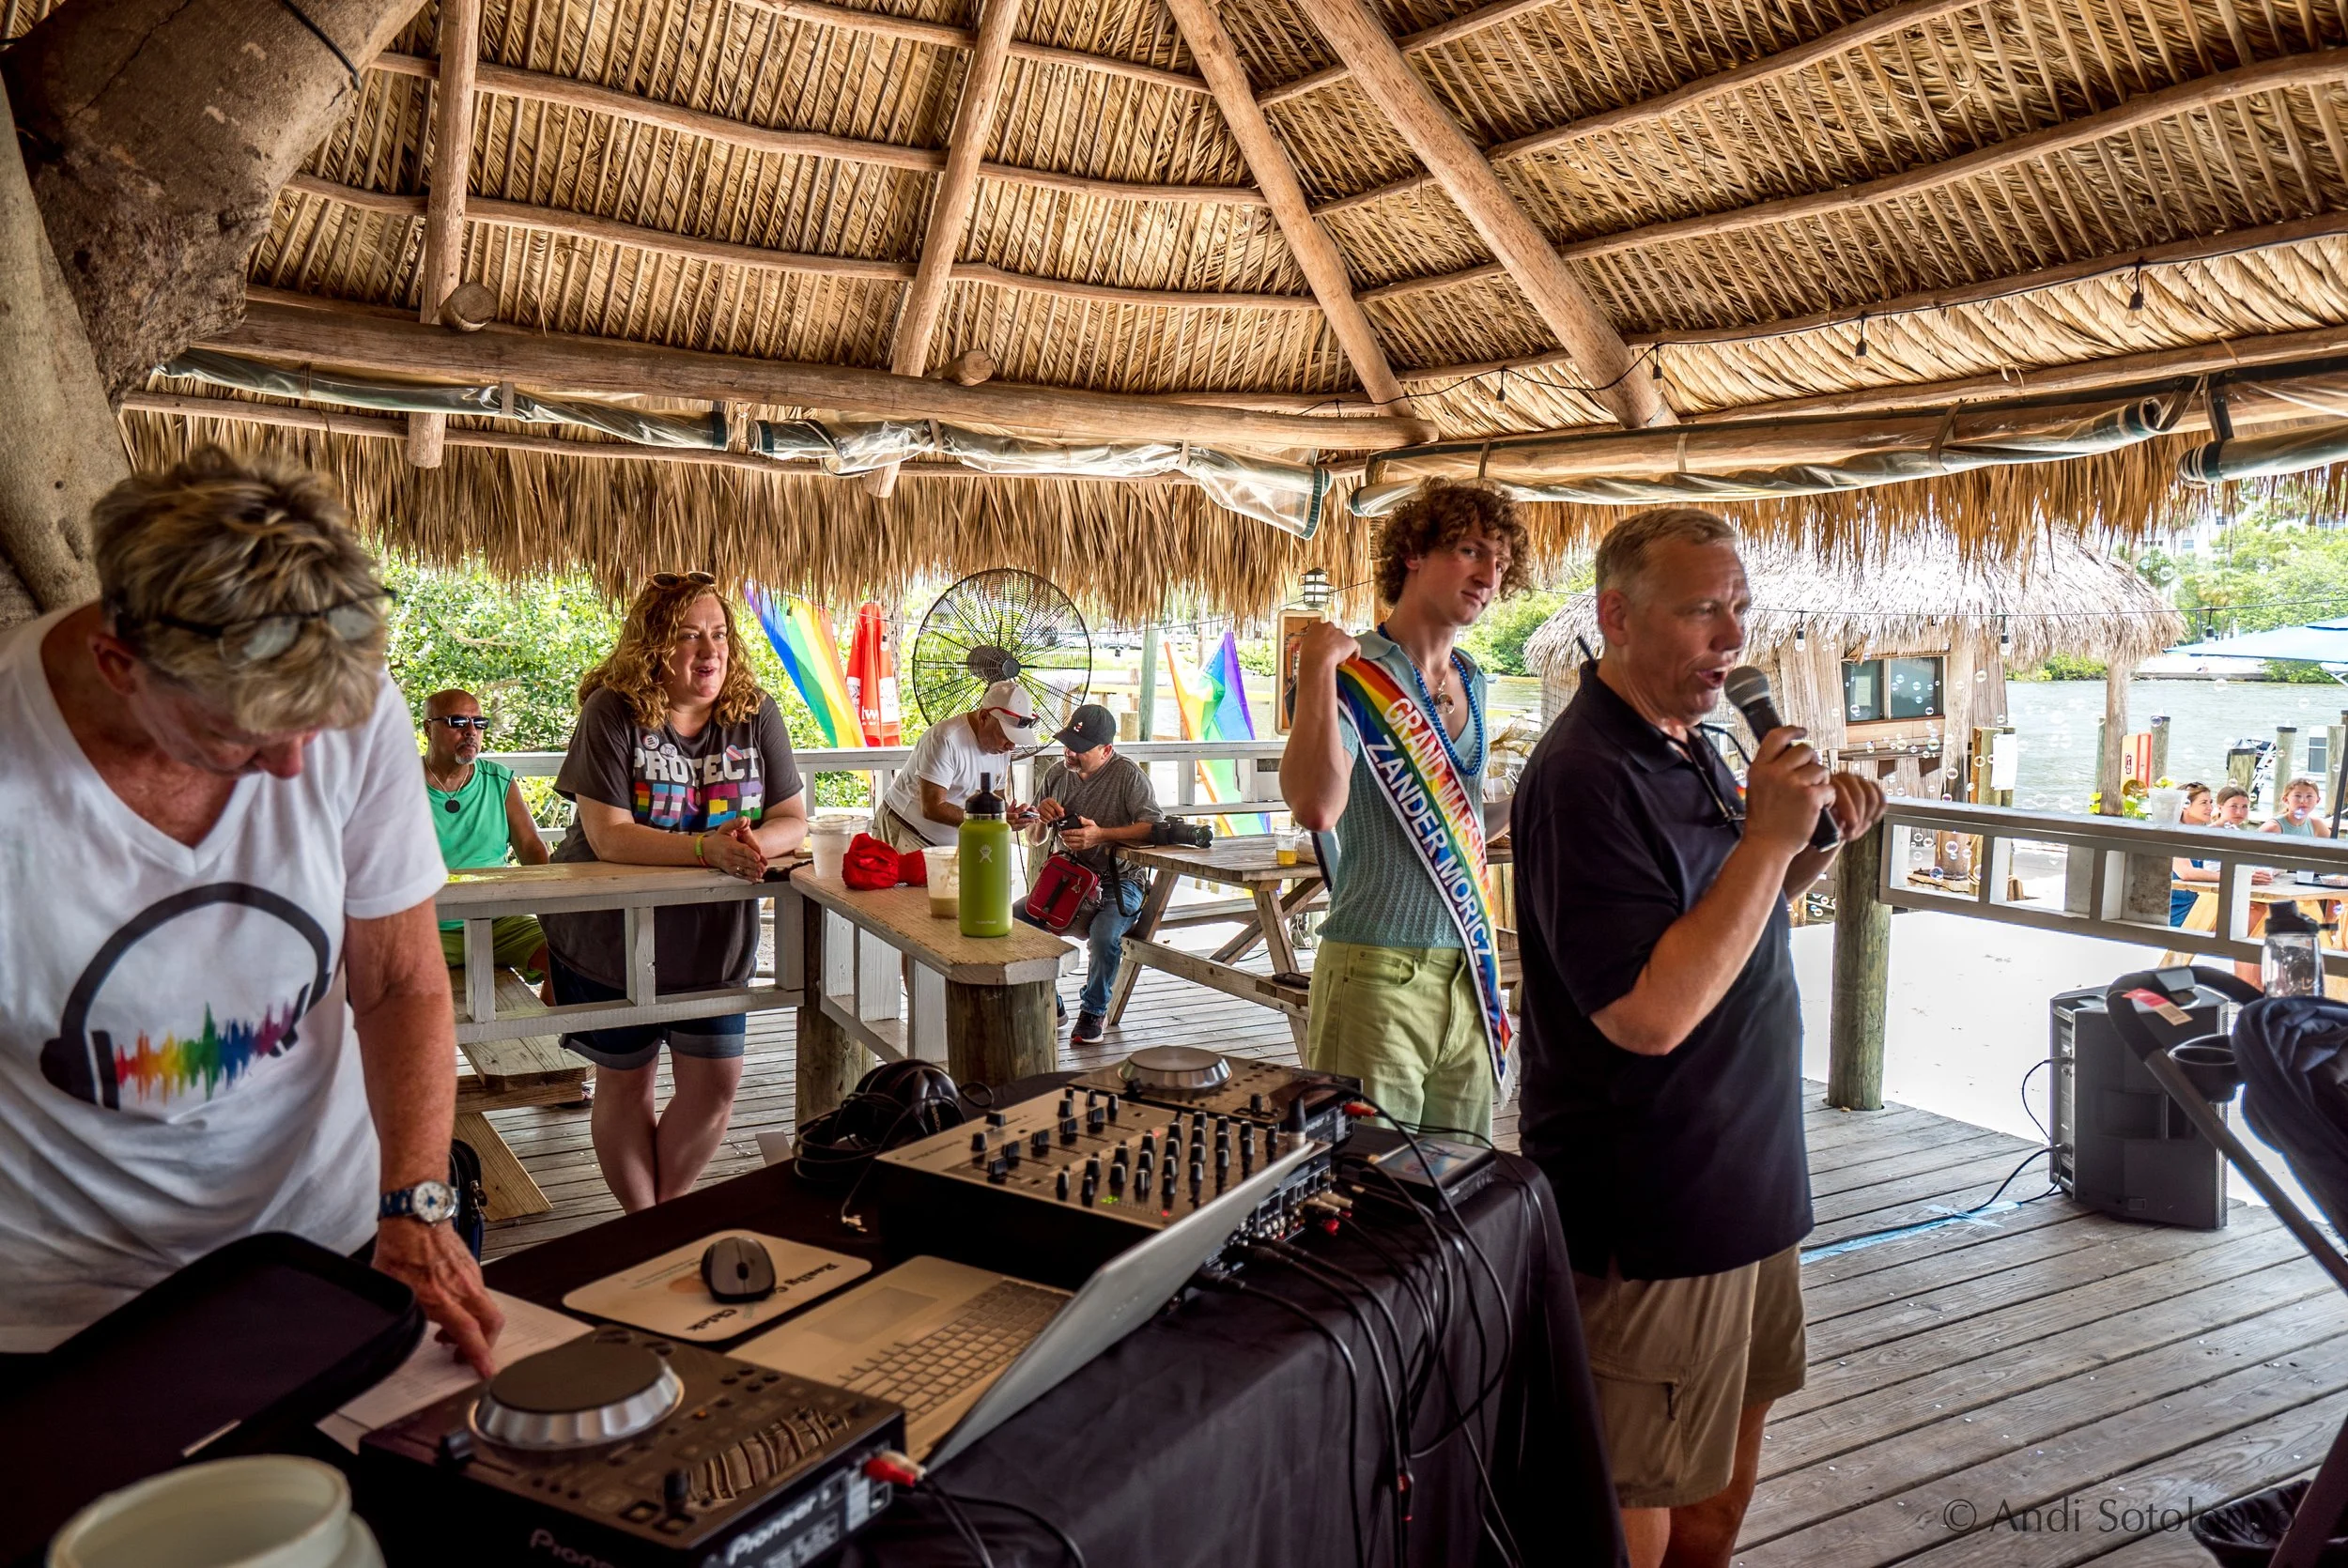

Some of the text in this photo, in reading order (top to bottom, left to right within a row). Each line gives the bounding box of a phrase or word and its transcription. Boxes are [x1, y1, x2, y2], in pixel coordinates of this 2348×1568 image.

[634, 746, 760, 787] PROTECT
[1384, 698, 1447, 781] GRAND
[1367, 734, 1493, 966] ZANDER MORICZ
